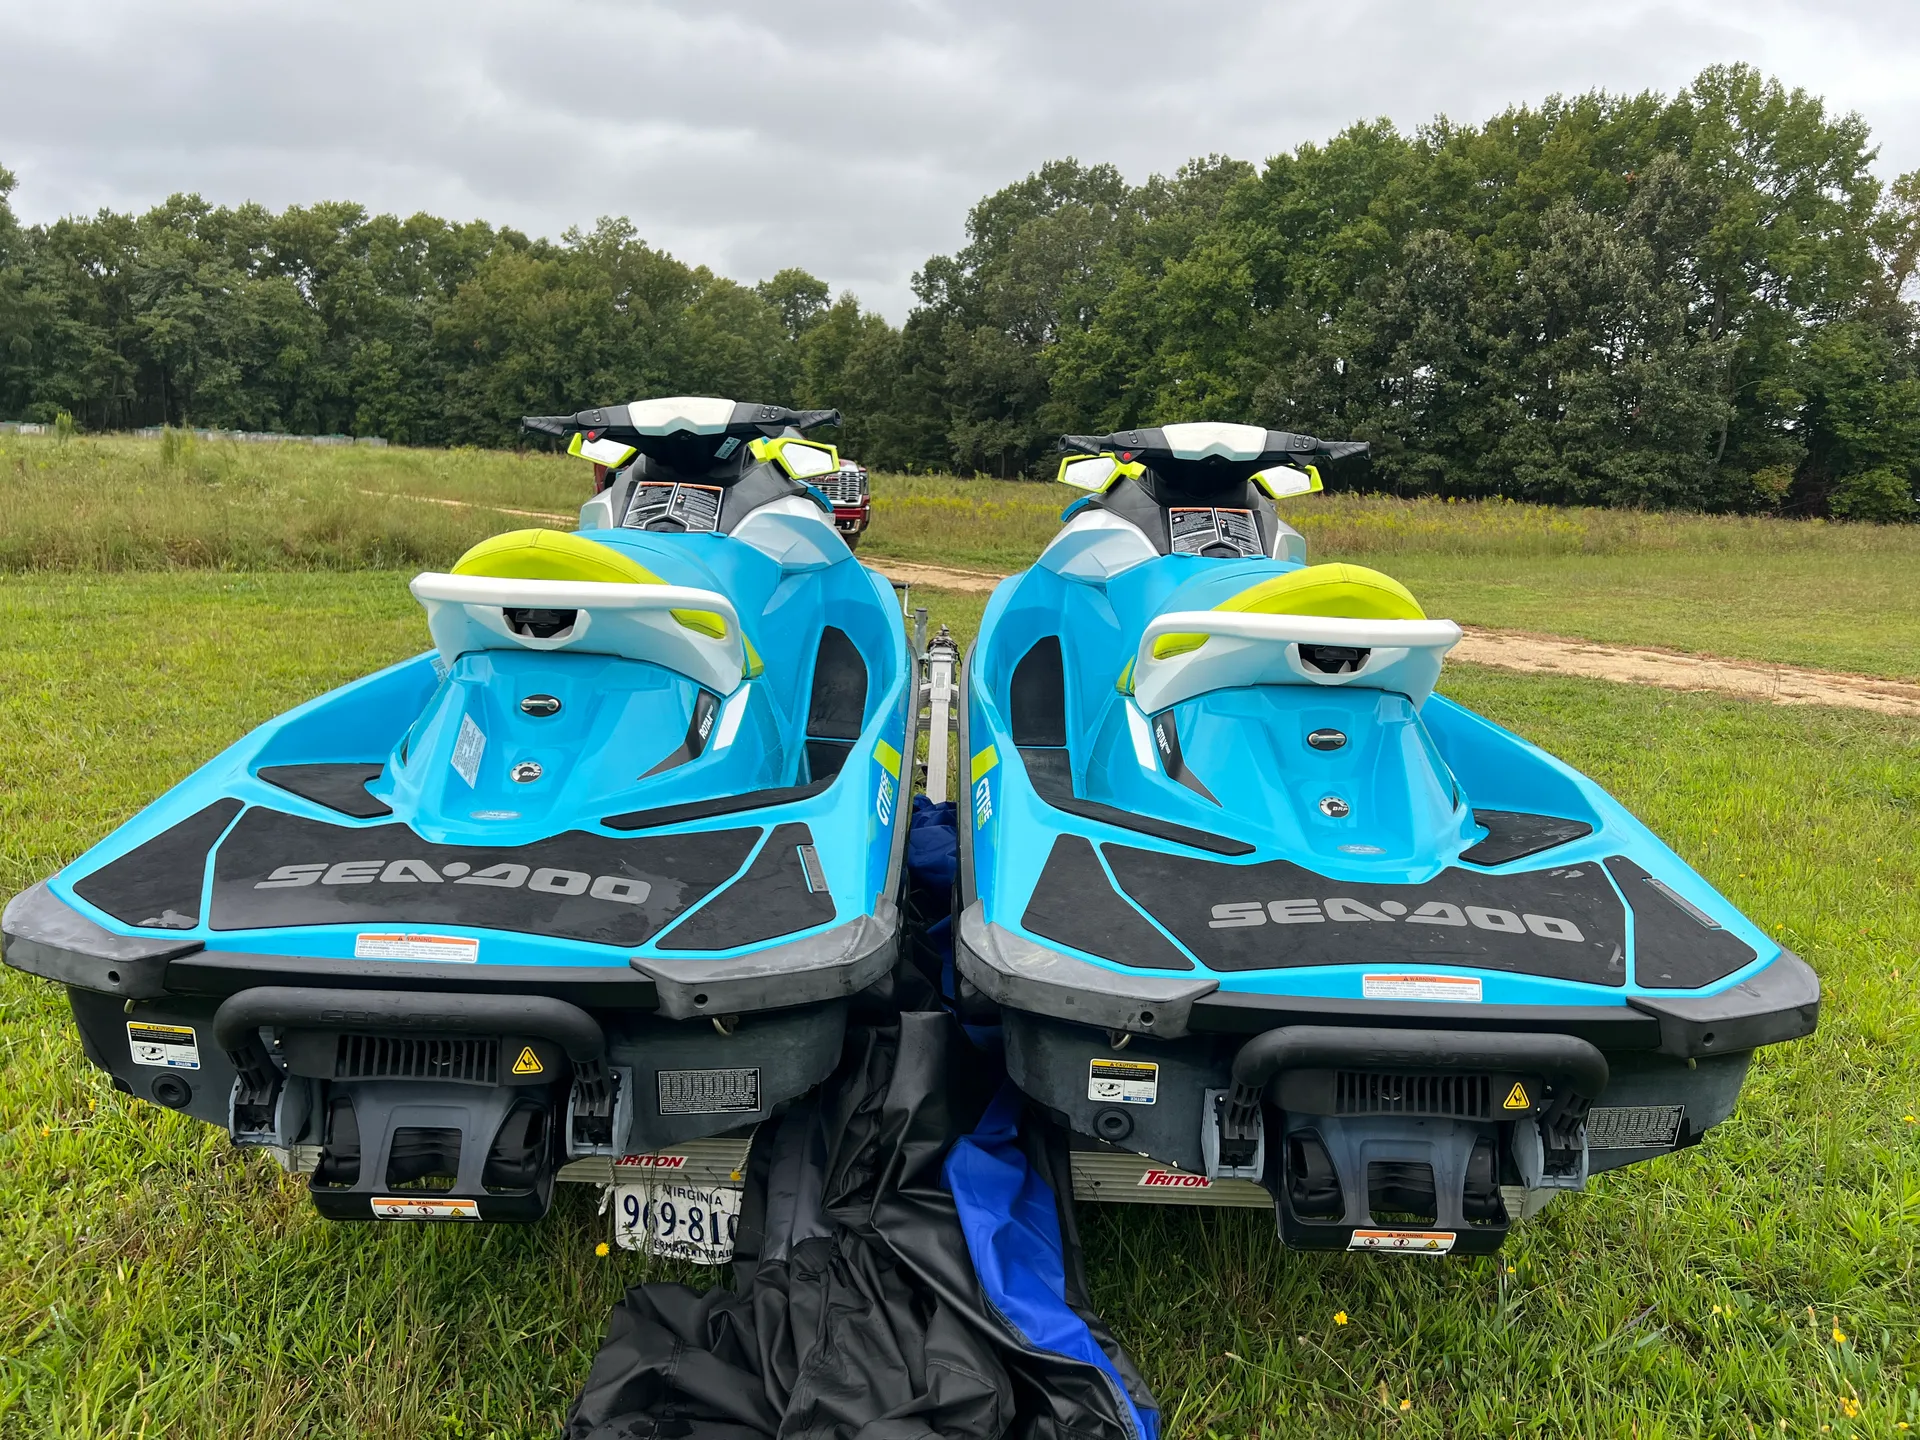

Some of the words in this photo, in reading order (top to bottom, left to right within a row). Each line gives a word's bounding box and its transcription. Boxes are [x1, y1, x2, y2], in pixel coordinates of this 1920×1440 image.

[1145, 1170, 1210, 1187] TRITON
[662, 1183, 723, 1206] VIRGINIA
[654, 1239, 701, 1258] ERMANENT
